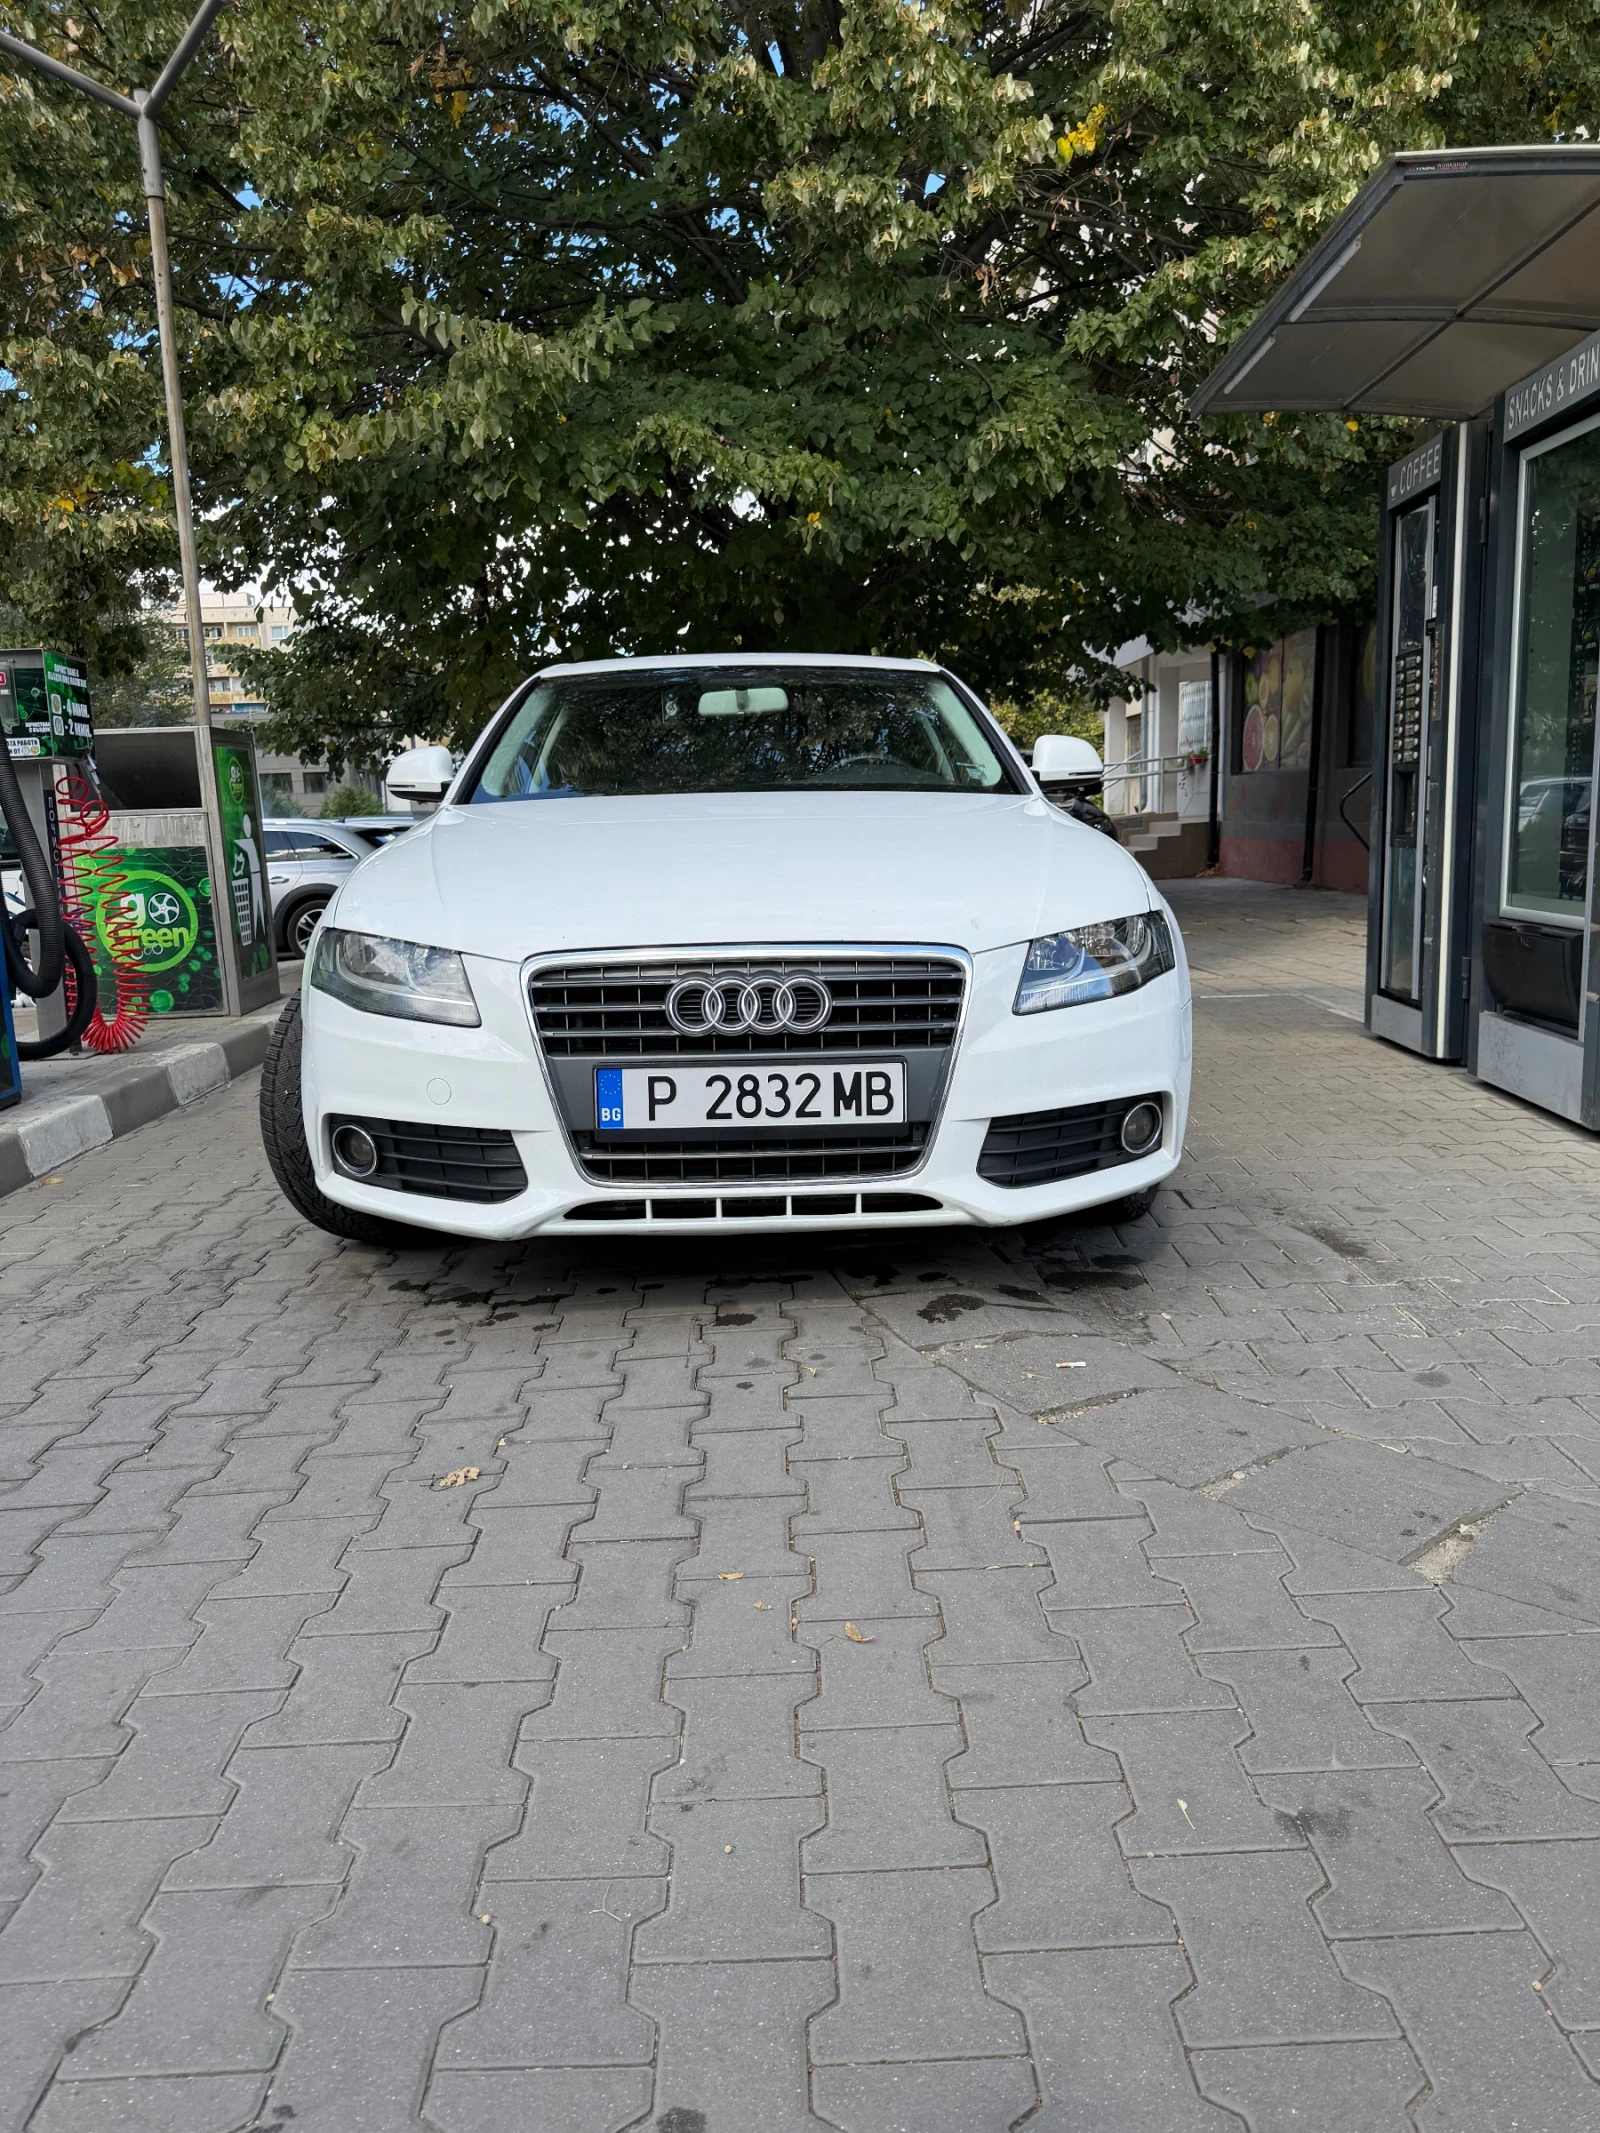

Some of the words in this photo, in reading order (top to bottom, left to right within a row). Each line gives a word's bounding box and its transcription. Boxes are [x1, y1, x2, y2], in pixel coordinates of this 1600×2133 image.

[1508, 373, 1553, 430] SNACKS
[1556, 366, 1565, 402] &
[1400, 443, 1440, 495] COFFEE
[105, 919, 189, 953] Green
[601, 1107, 622, 1122] BG
[647, 1076, 677, 1121] P
[705, 1072, 822, 1120] 2832
[833, 1070, 895, 1118] MB
